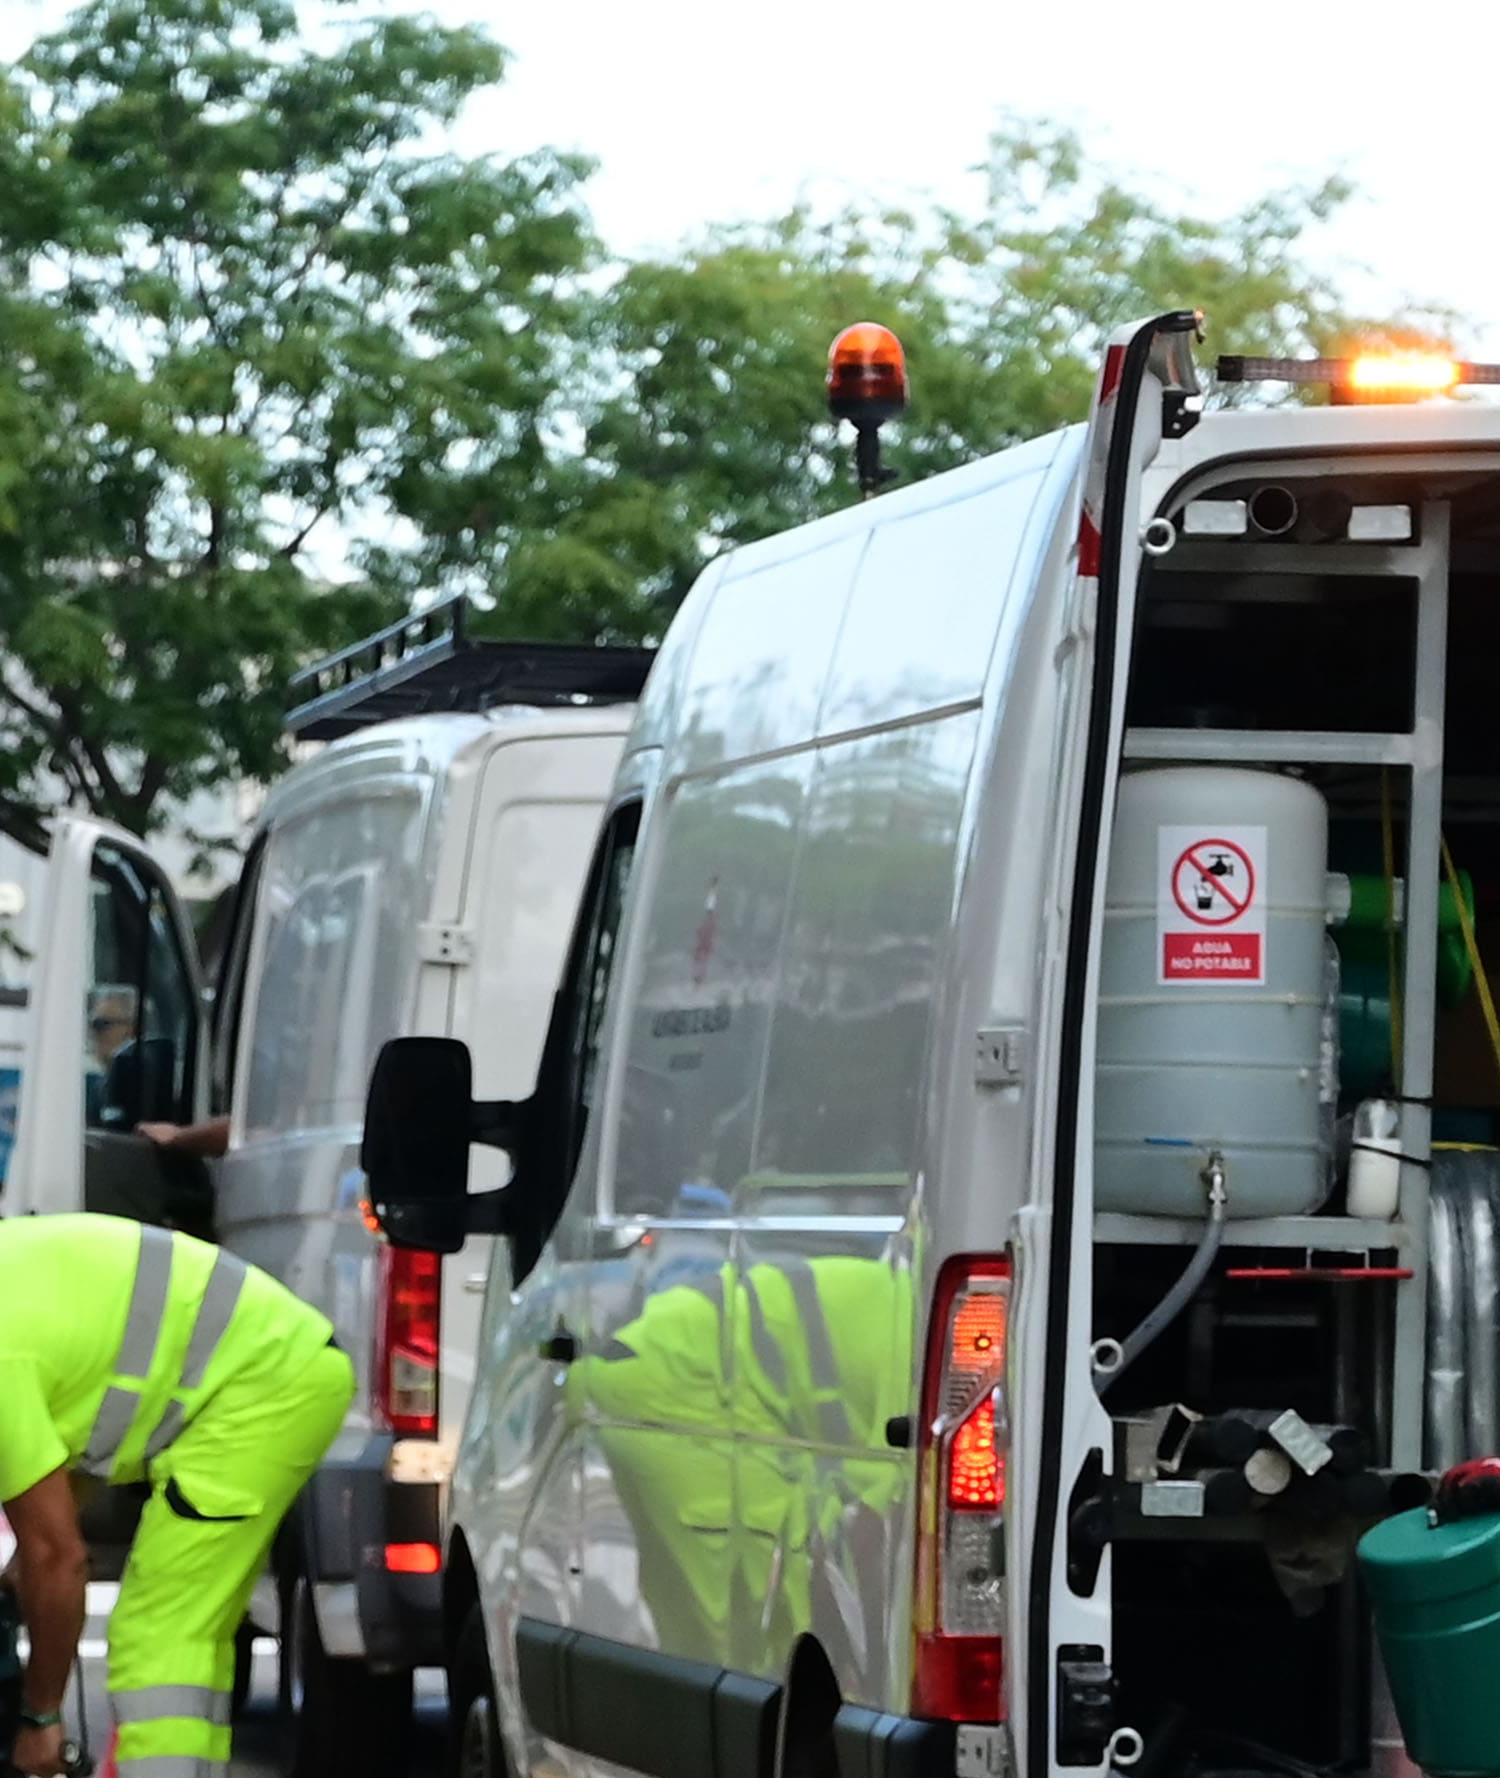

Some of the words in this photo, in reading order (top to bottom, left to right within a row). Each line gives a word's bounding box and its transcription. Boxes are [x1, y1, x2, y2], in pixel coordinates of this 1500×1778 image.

[1192, 941, 1233, 954] AGUA
[1171, 956, 1193, 970] NO
[1194, 956, 1252, 970] POTABLE
